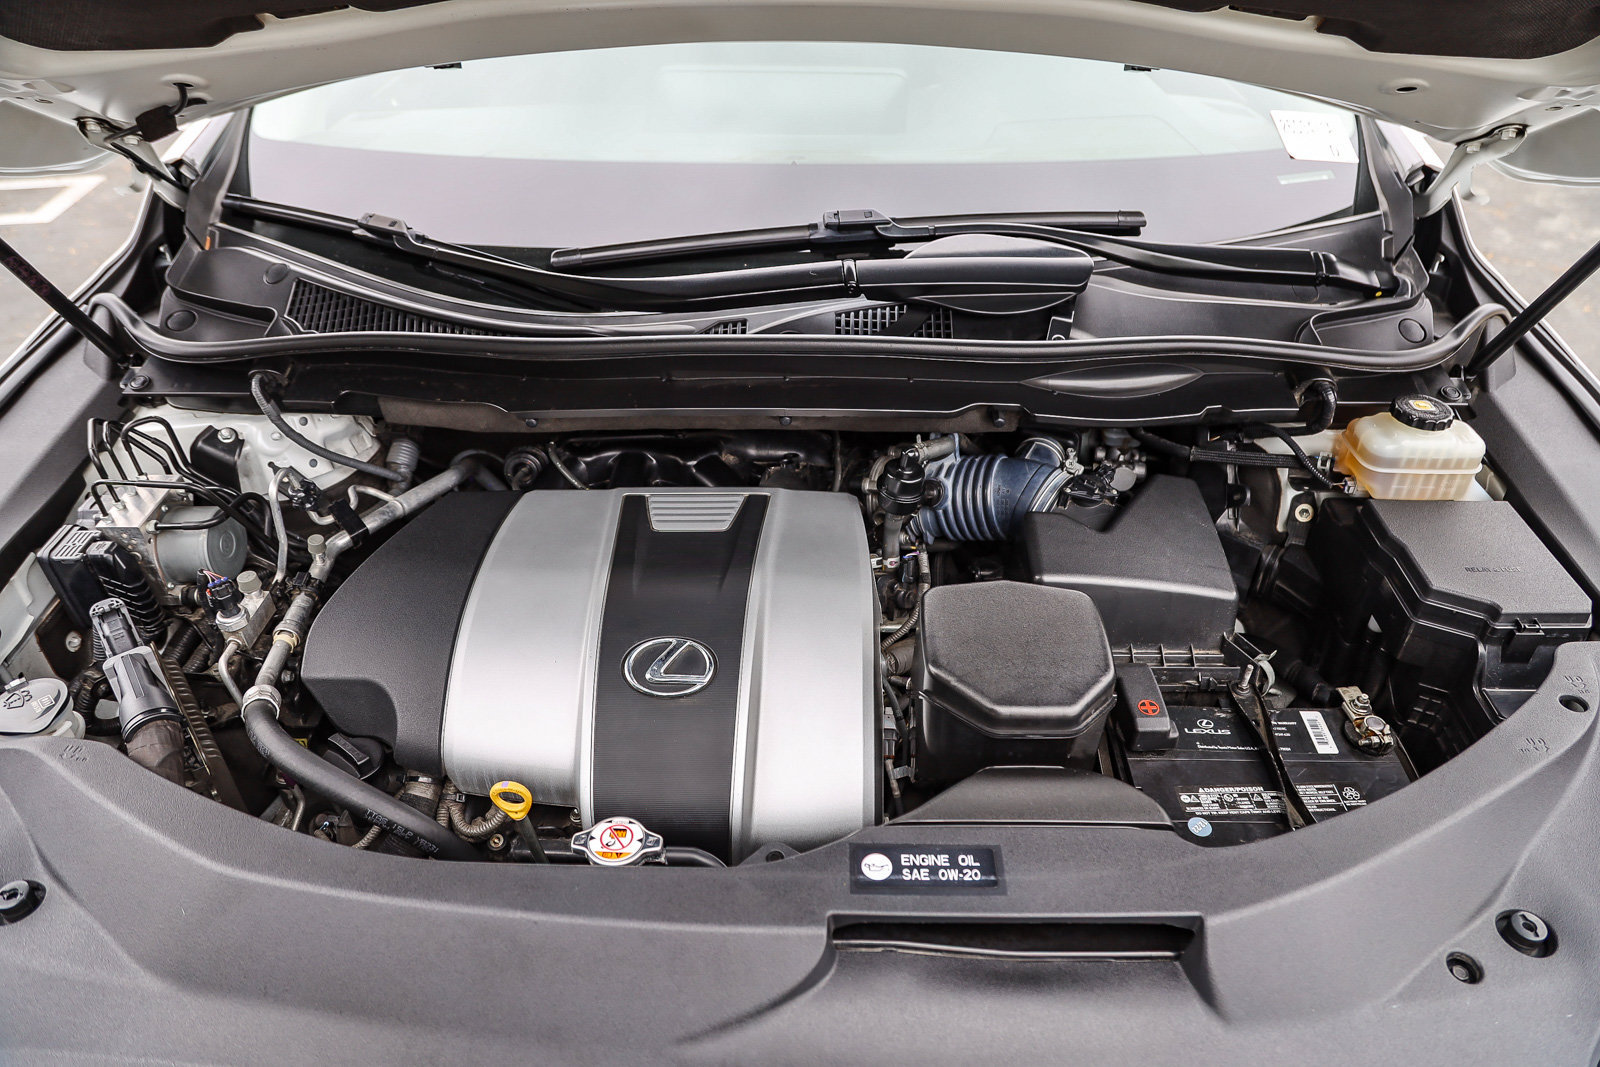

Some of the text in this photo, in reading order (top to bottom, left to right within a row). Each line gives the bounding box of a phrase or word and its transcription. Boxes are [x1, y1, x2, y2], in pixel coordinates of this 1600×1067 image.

[900, 854, 981, 866] ENGINE OIL
[902, 868, 981, 881] SAE 0W-20
